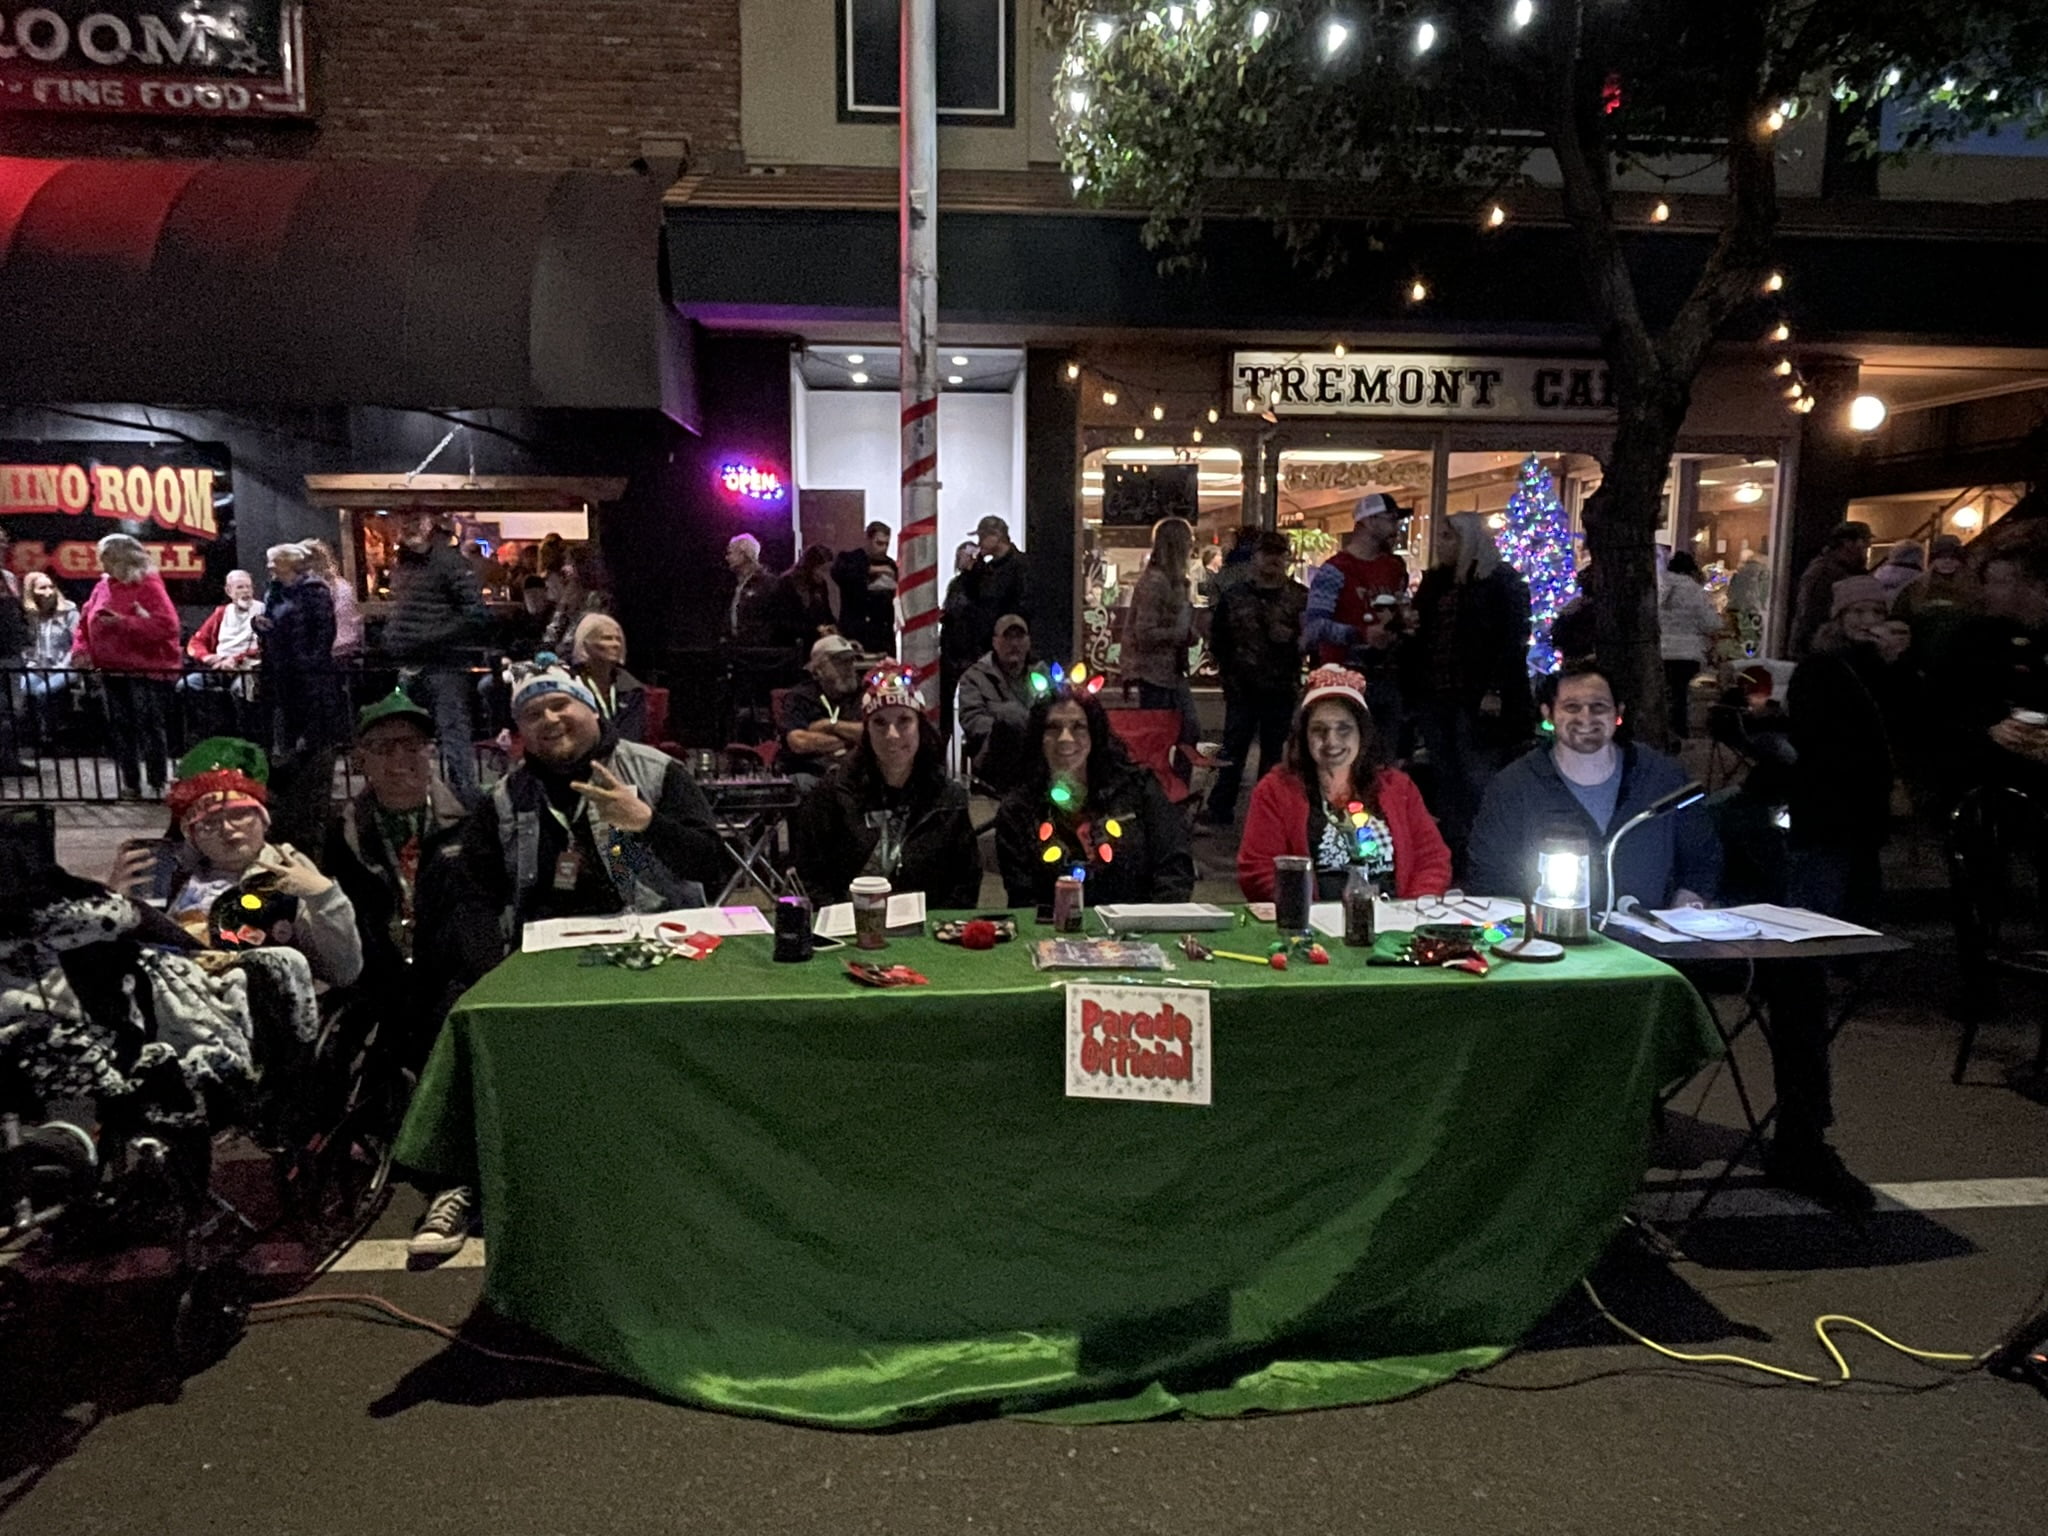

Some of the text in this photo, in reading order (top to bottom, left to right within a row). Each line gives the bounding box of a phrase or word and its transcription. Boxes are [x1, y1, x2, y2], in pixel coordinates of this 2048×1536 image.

[0, 7, 214, 65] OOM
[32, 77, 251, 111] FINE FOOD
[1237, 365, 1502, 407] TREMONT
[95, 466, 218, 536] ROOM
[724, 470, 776, 492] OPEN
[58, 544, 204, 572] GLL
[1081, 998, 1193, 1042] Parade
[1080, 1033, 1193, 1082] Official
